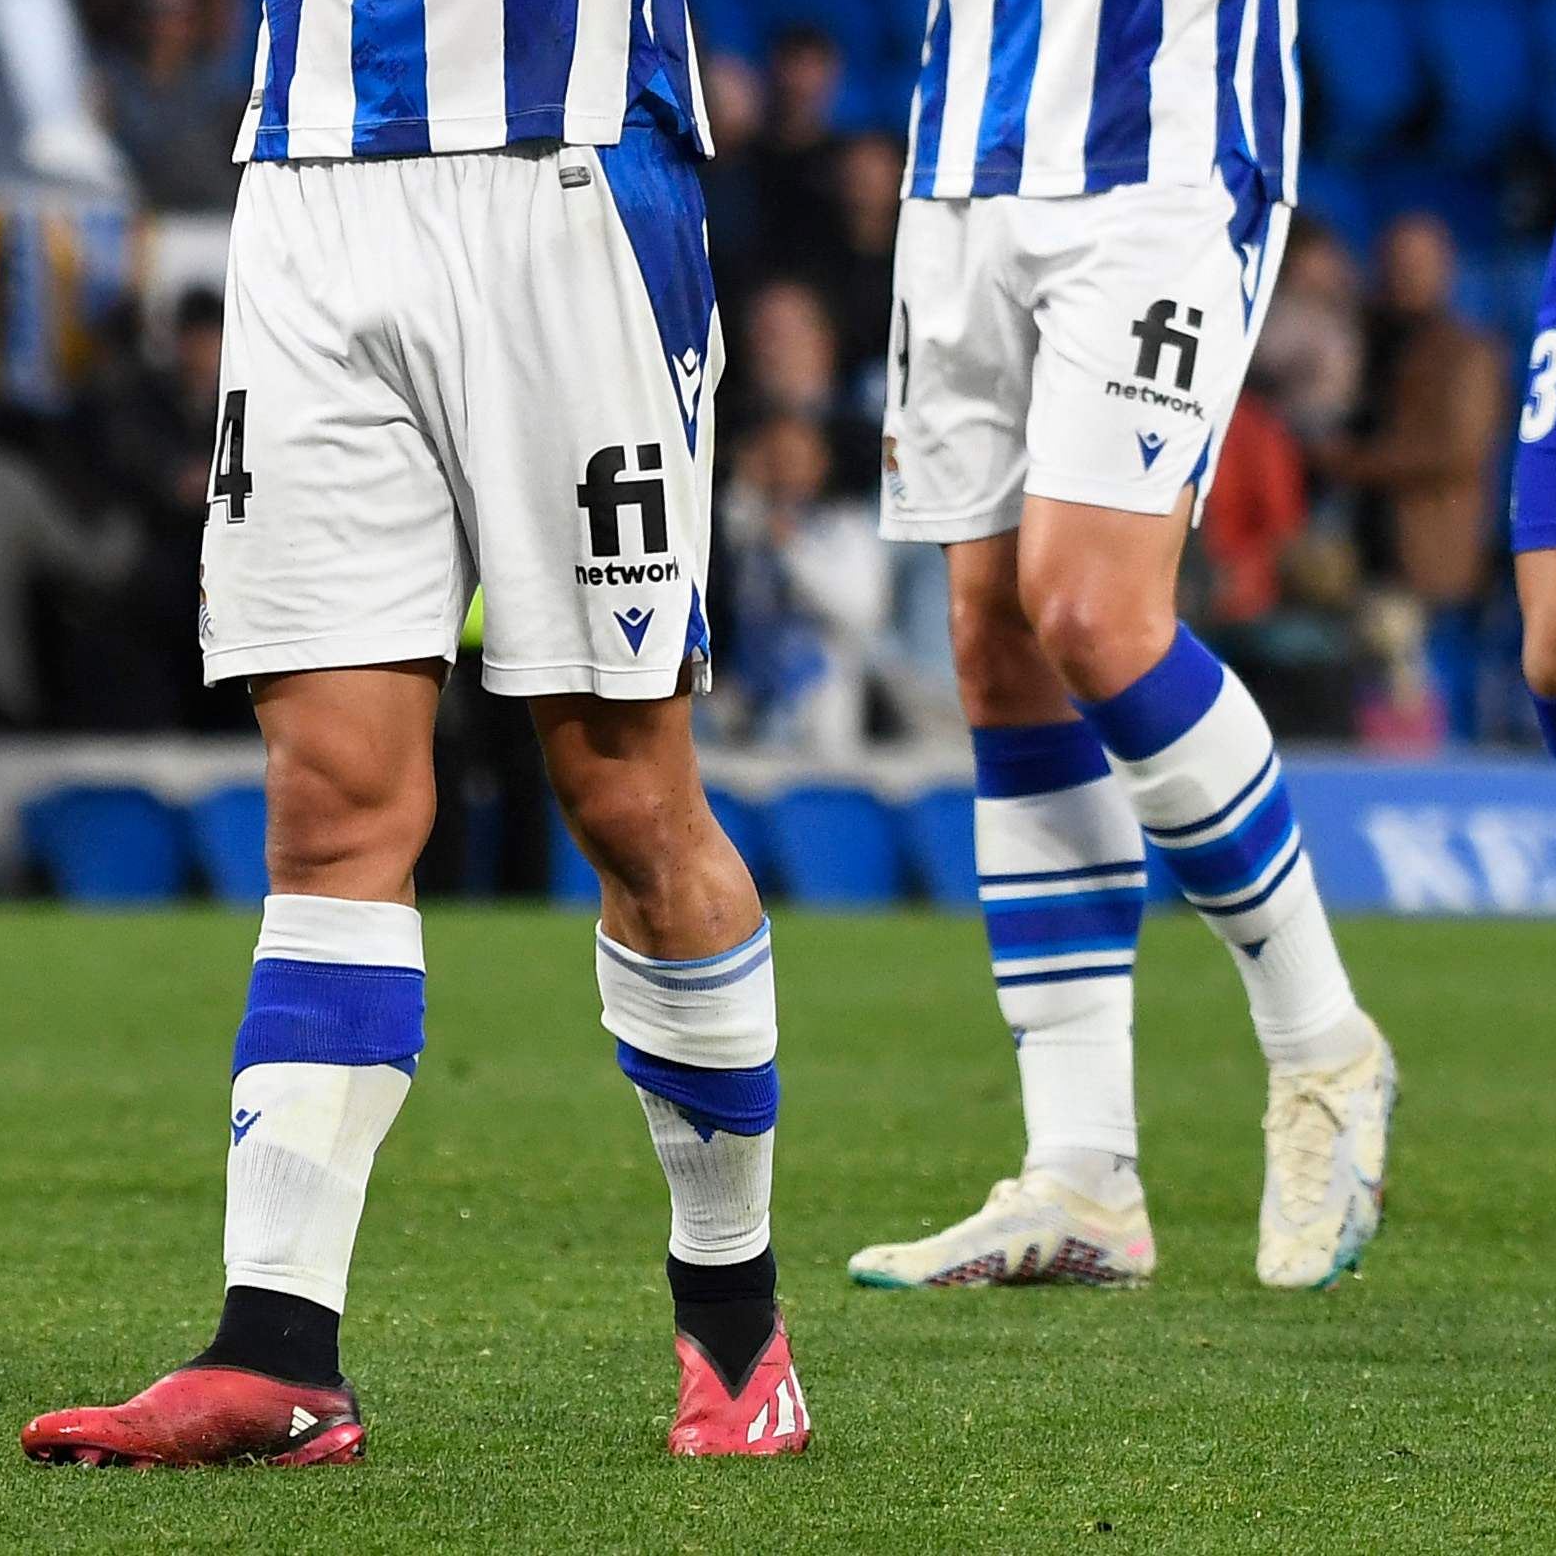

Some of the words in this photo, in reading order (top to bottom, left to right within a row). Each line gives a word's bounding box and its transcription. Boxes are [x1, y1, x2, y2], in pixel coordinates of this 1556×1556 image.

[1130, 299, 1204, 392] fi
[1105, 380, 1205, 421] network
[205, 389, 253, 525] 4
[576, 443, 668, 557] fi
